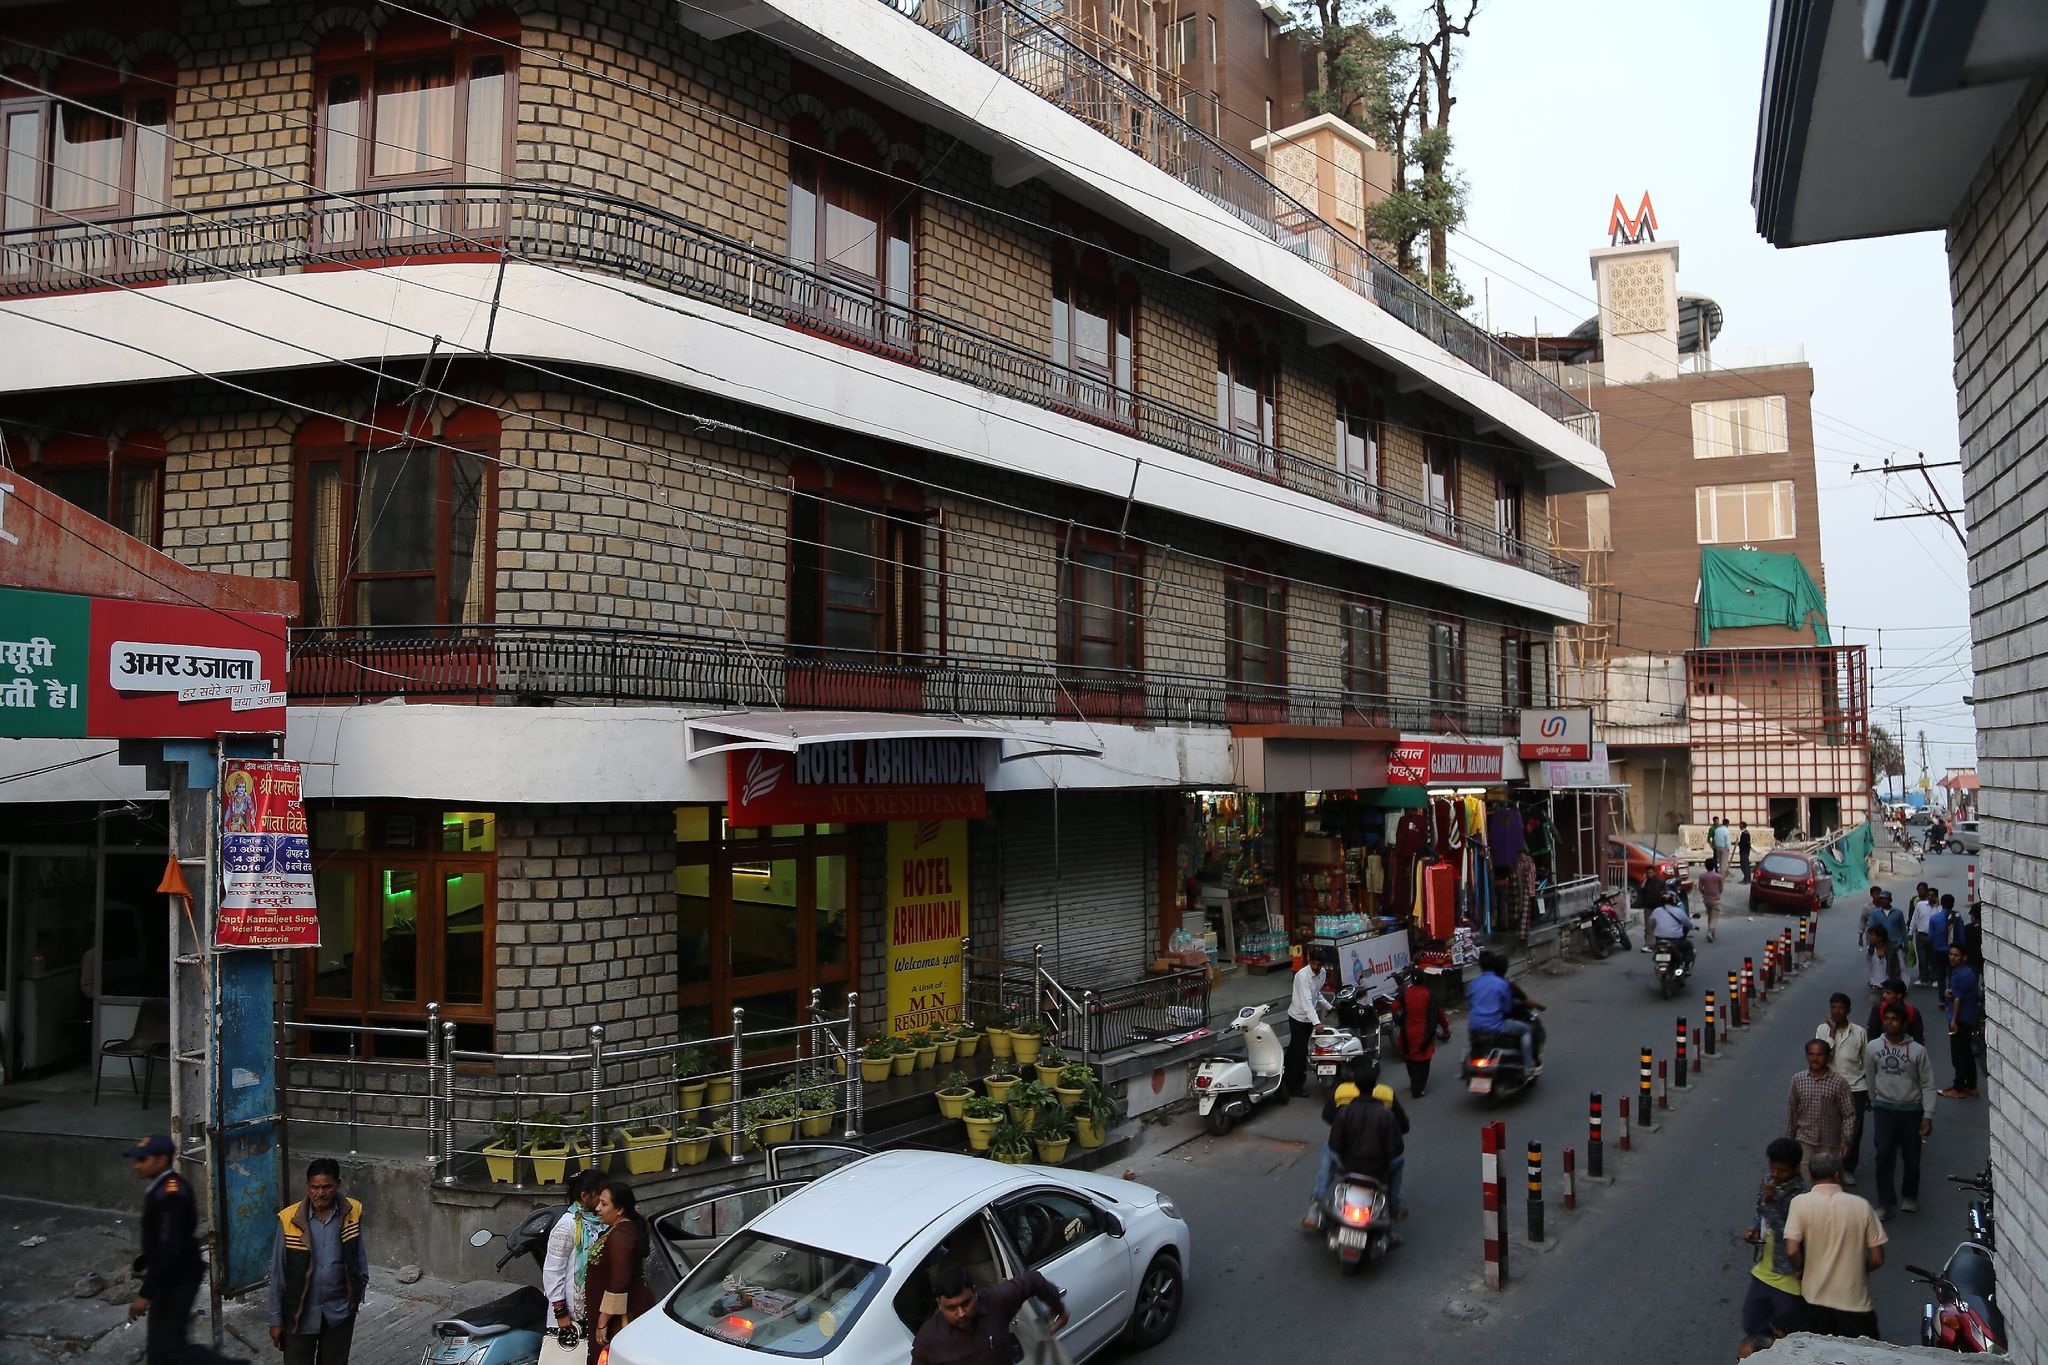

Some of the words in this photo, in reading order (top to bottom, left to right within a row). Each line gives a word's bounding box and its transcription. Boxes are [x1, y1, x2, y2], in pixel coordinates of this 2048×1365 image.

[0, 678, 39, 707] ती
[182, 688, 196, 699] हर
[225, 684, 243, 695] नया
[250, 680, 271, 694] जोश
[234, 697, 252, 707] नया
[257, 694, 285, 706] उजाला
[797, 741, 858, 784] HOTEL
[864, 739, 981, 784] ABHINANDAN
[1431, 753, 1465, 774] GARHWAL
[1466, 754, 1501, 774] HANDLOOM
[260, 772, 272, 795] श्री
[874, 792, 979, 815] RESIDENCY
[304, 849, 310, 858] 3
[286, 862, 290, 871] 6
[903, 857, 952, 898] HOTEL
[251, 896, 294, 908] मसूरी
[220, 915, 244, 924] Capt.
[246, 915, 292, 925] Kamaljeet
[295, 915, 318, 925] Singh
[893, 899, 961, 946] ABHINANDAN
[249, 935, 289, 943] Mussorie
[894, 956, 940, 972] Welcomes
[942, 954, 960, 969] you
[1368, 954, 1393, 976] Amul
[919, 983, 934, 992] Unit
[909, 995, 926, 1012] M
[931, 992, 946, 1008] N
[894, 1006, 961, 1032] RESIDENCY
